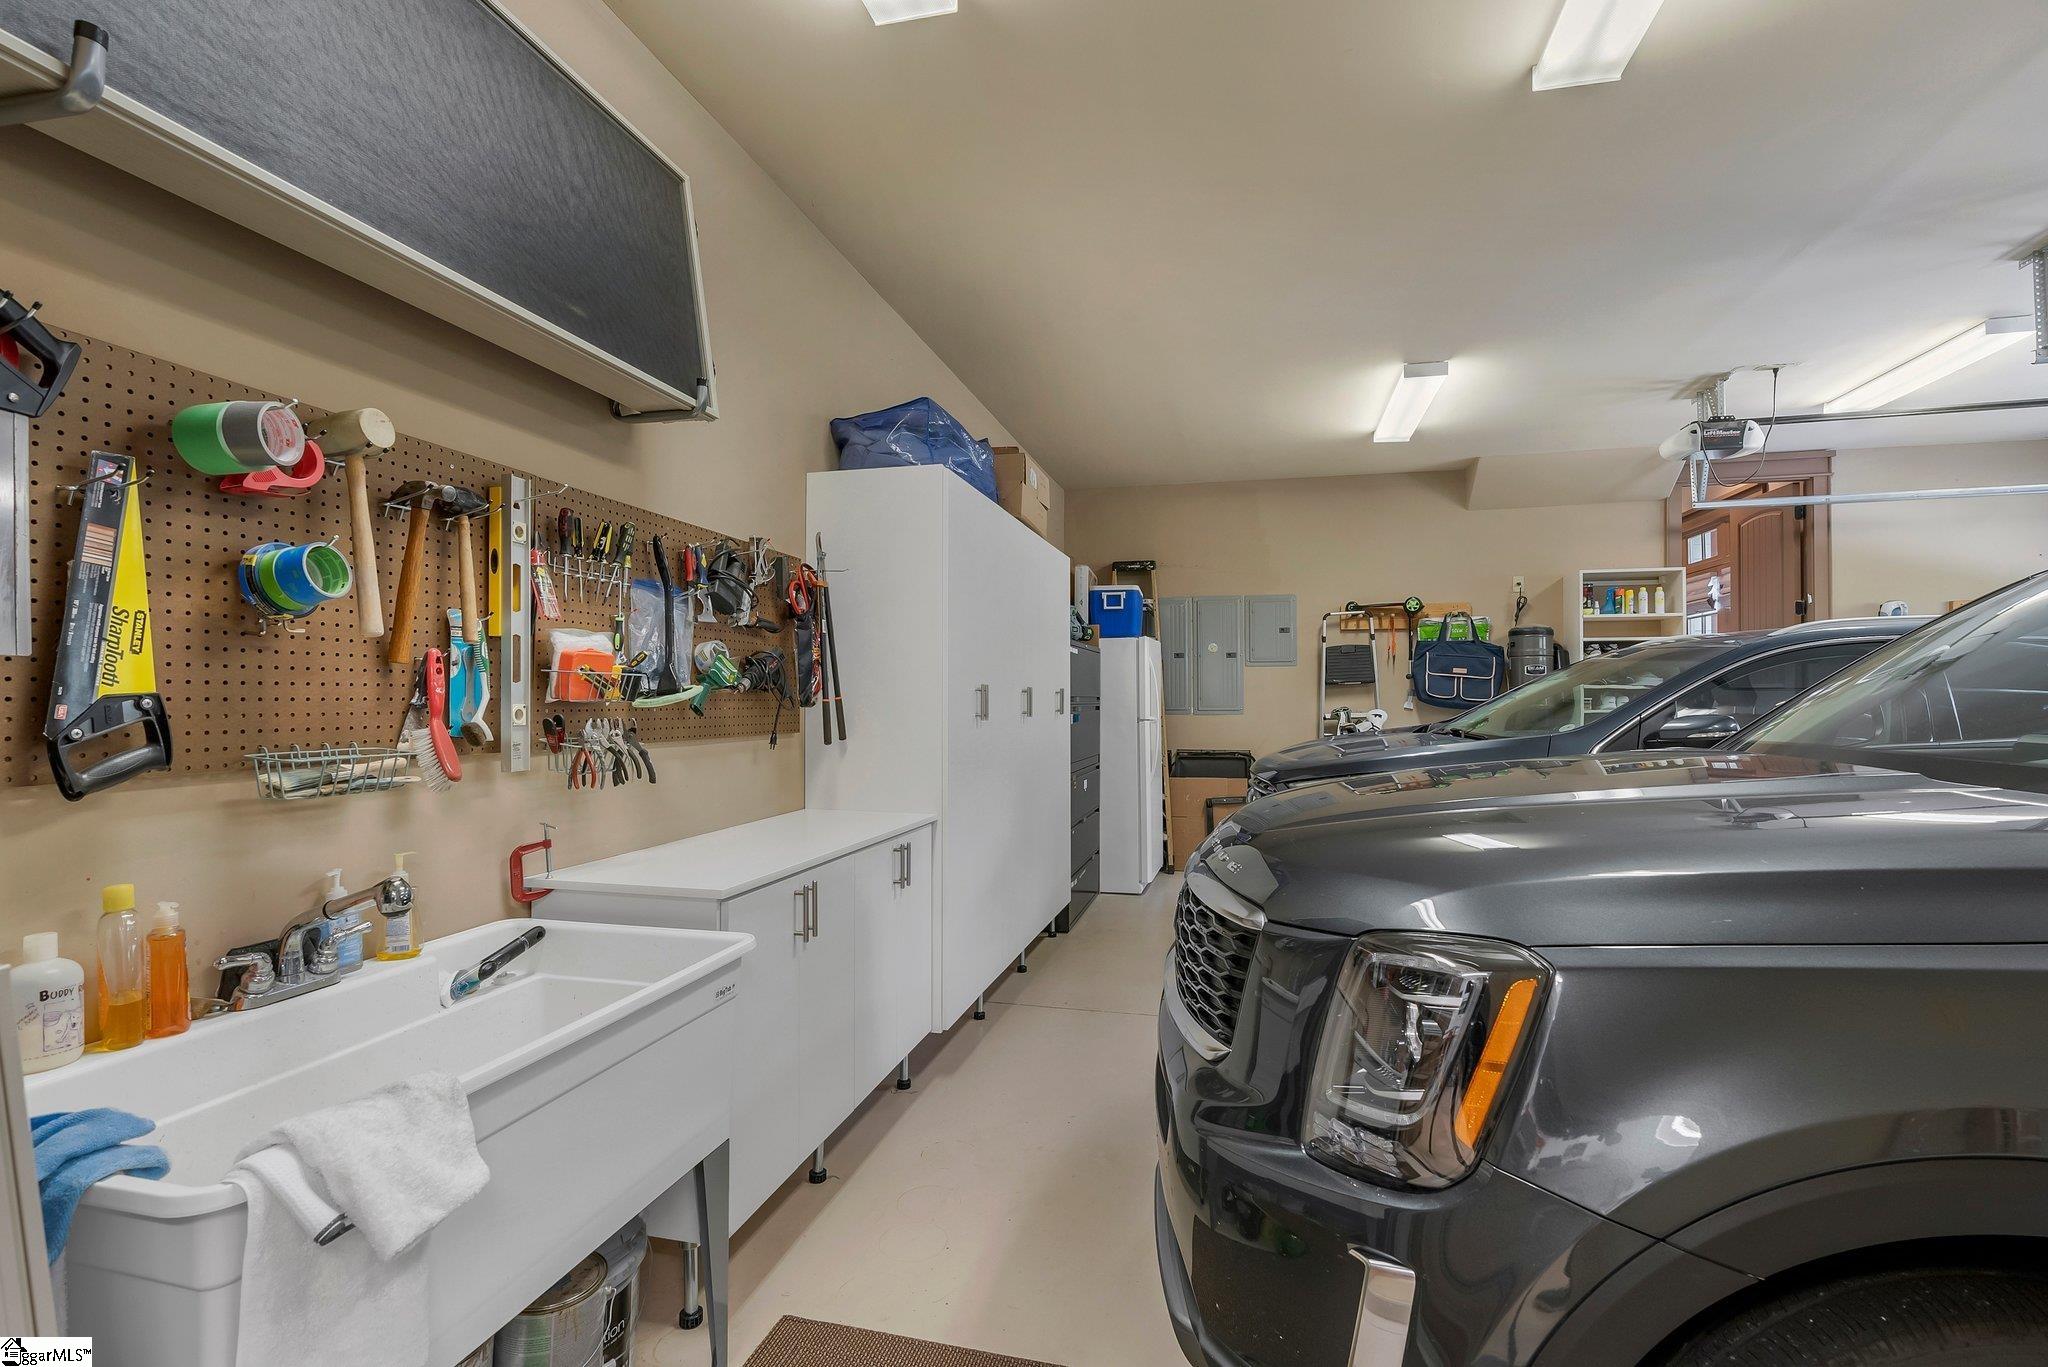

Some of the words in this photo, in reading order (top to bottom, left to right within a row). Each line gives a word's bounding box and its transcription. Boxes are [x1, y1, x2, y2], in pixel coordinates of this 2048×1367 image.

[101, 605, 130, 687] SharpTooth
[132, 611, 145, 654] STANLEY
[39, 987, 75, 1002] BUDDY
